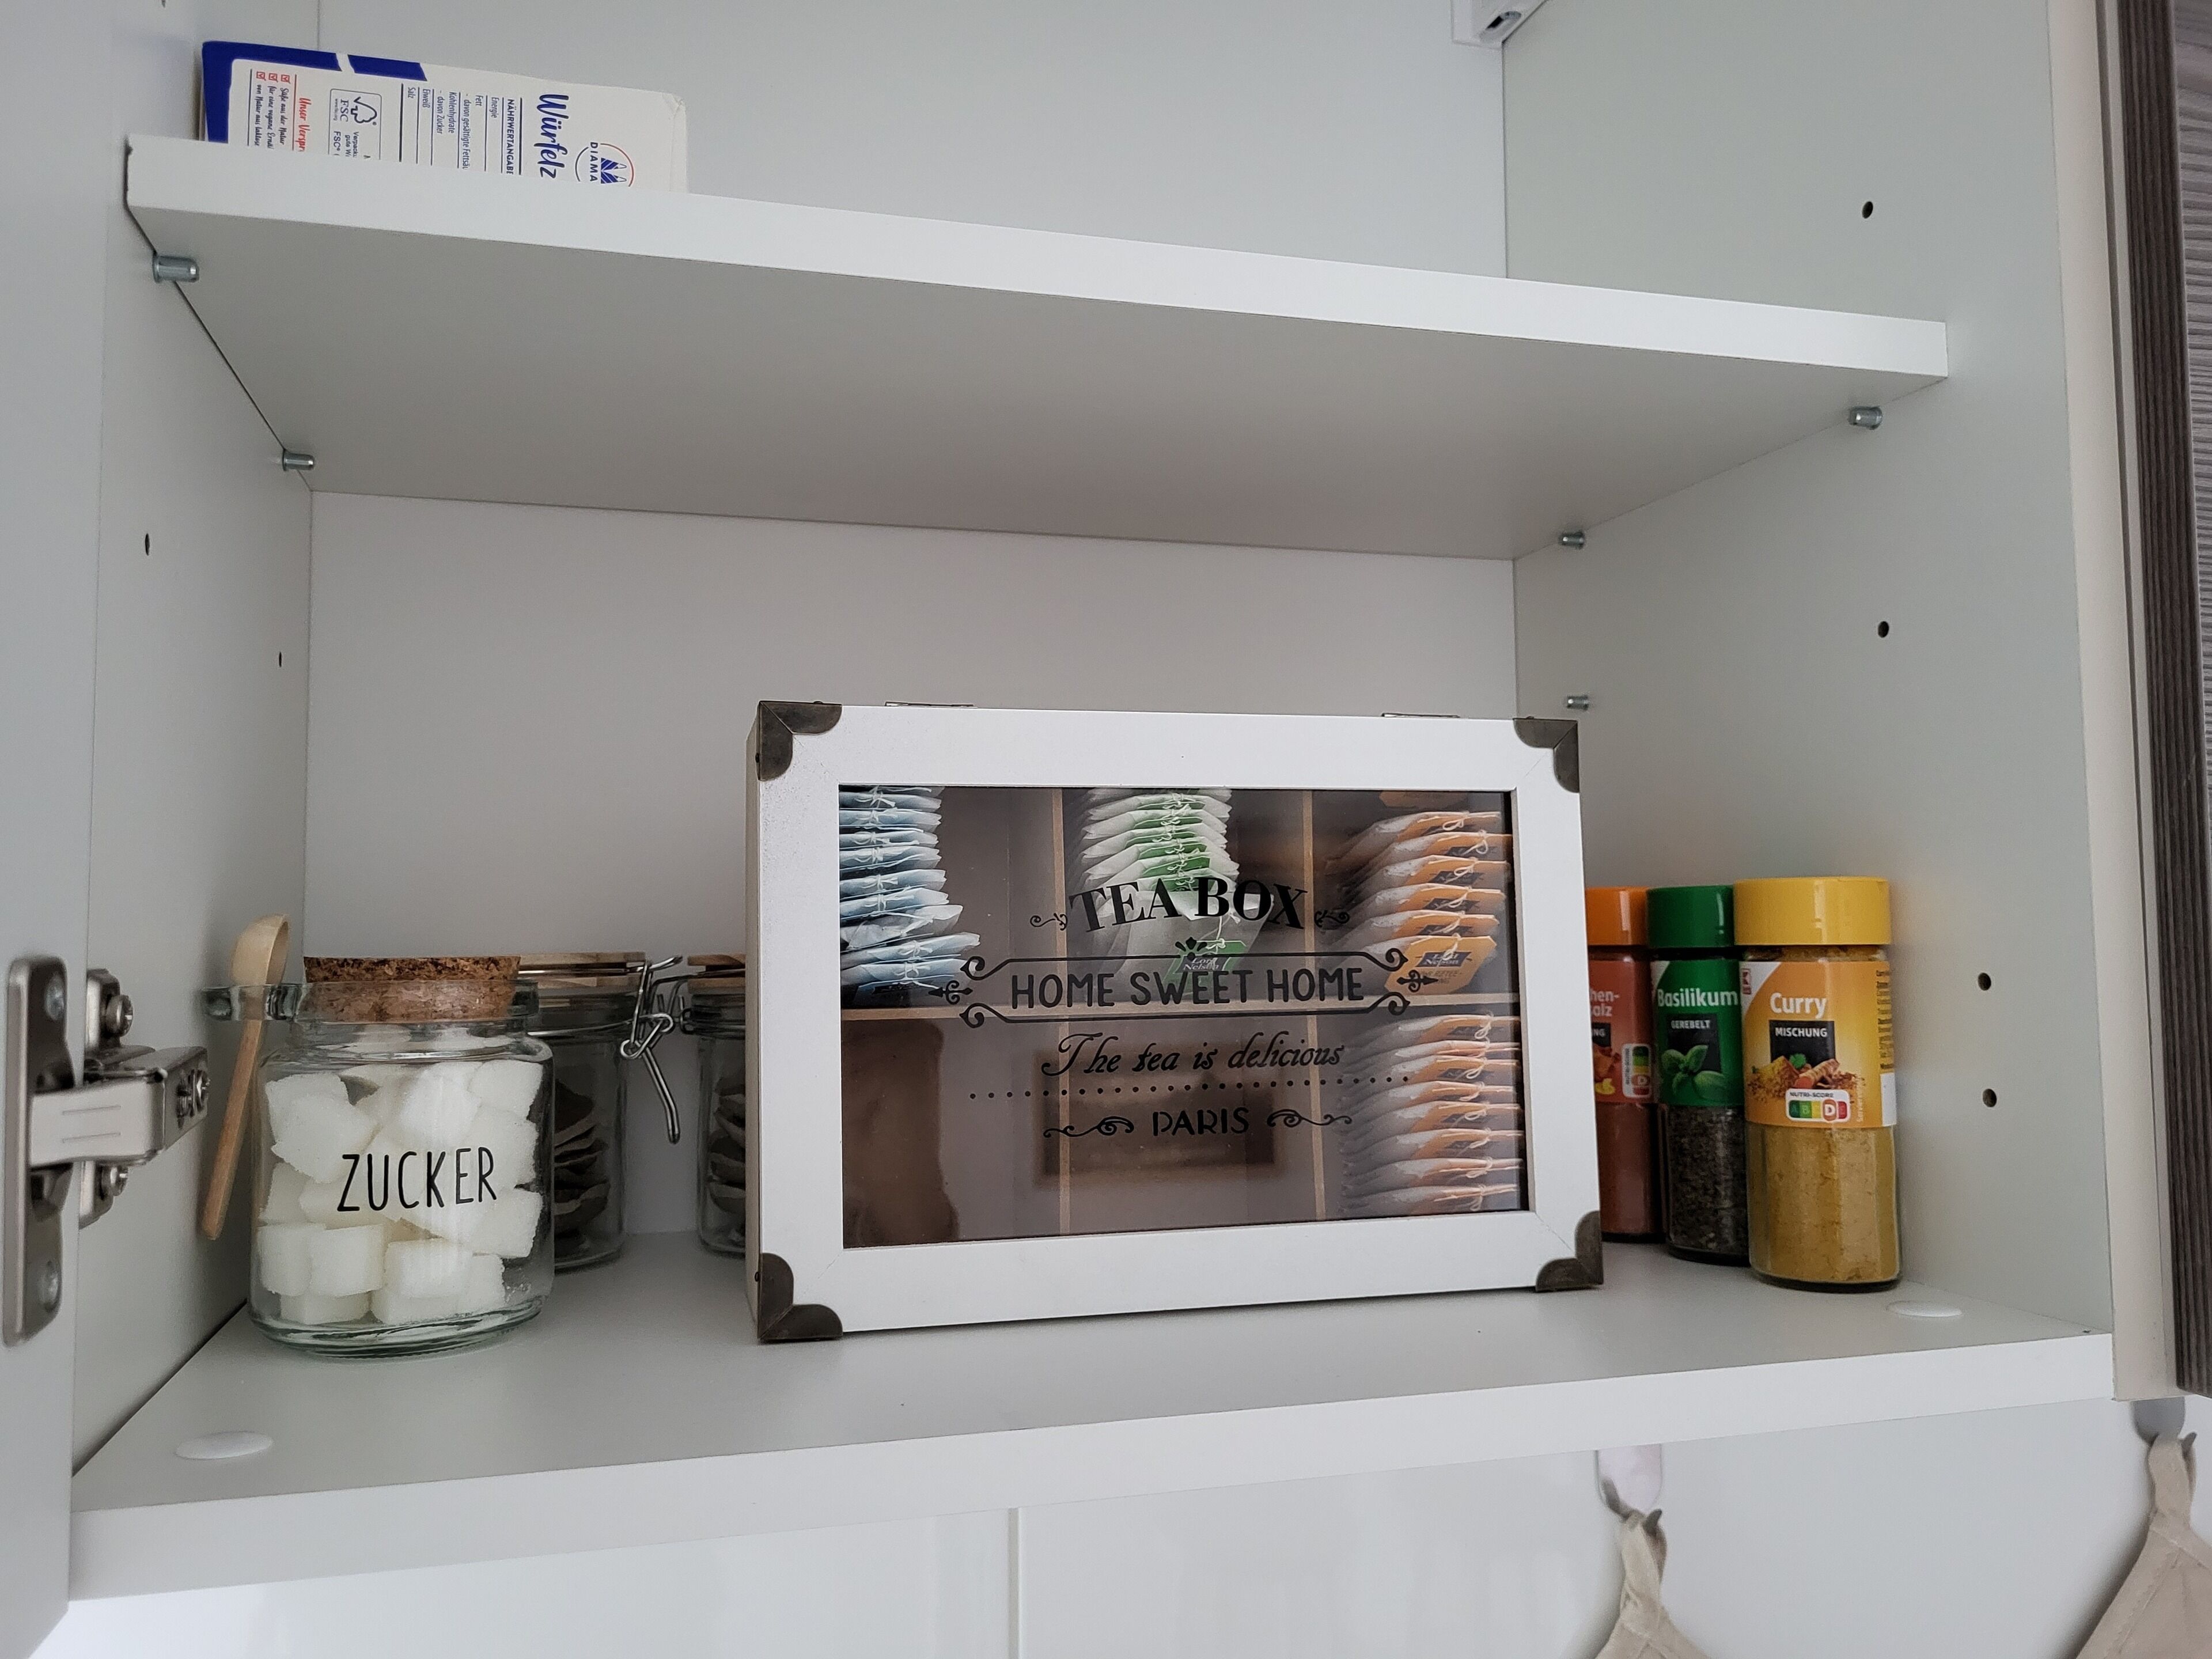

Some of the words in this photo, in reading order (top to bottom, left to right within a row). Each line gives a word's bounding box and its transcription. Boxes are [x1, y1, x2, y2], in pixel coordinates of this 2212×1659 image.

[267, 85, 277, 95] für
[279, 87, 289, 102] Süße
[407, 87, 416, 99] Salz
[422, 89, 431, 108] Eiweiß
[255, 96, 264, 113] Natur
[299, 97, 312, 121] Unser
[340, 99, 349, 122] FSC
[437, 96, 445, 114] davon
[463, 99, 472, 117] davon
[475, 95, 484, 107] Fett
[490, 97, 499, 119] Energie
[265, 109, 274, 130] vegane
[280, 115, 288, 125] der
[447, 92, 457, 134] Kohlenhydrate
[436, 116, 445, 134] Zucker
[461, 118, 471, 147] gesättigte
[278, 127, 287, 145] Natur
[295, 124, 310, 151] Verspr
[533, 94, 570, 179] Würfelz
[589, 142, 599, 182] DIAMA
[1069, 878, 1182, 933] TEA
[1194, 877, 1309, 930] BOX
[1012, 972, 1115, 1009] HOME
[1130, 968, 1253, 1006] SWEET
[1267, 967, 1365, 1003] HOME
[1657, 987, 1738, 1007] Basilikum
[1770, 992, 1827, 1020] Curry
[1671, 1019, 1711, 1030] GEREBELT
[1775, 1027, 1828, 1037] MISCHUNG
[1041, 1032, 1122, 1077] The
[1132, 1042, 1179, 1073] tea
[1192, 1041, 1218, 1071] is
[1228, 1030, 1344, 1070] delicious
[1823, 1103, 1836, 1116] D
[1152, 1107, 1250, 1137] PARIS
[337, 1146, 497, 1212] ZUCKER
